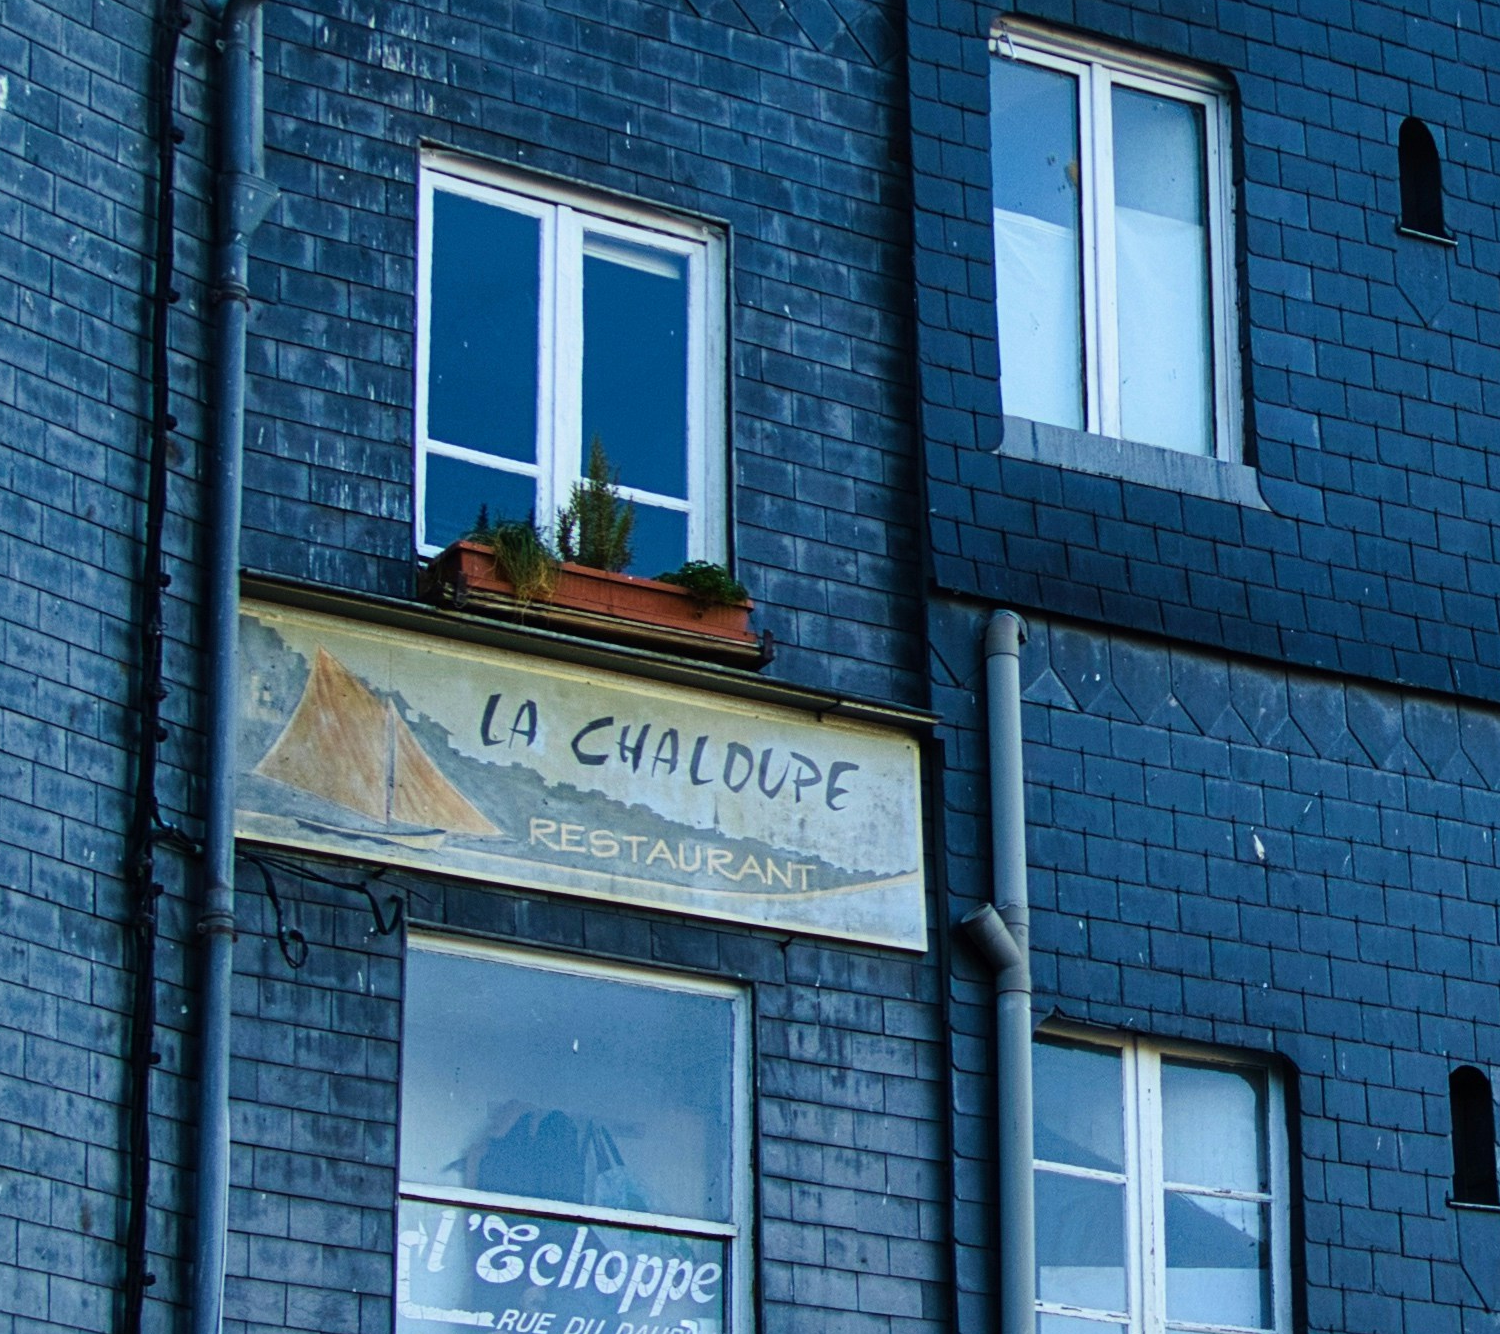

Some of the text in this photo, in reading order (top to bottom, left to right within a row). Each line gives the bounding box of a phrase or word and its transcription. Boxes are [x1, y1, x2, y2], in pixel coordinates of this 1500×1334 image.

[479, 693, 860, 811] LA CHALOUPE
[529, 818, 817, 891] RESTAURANT
